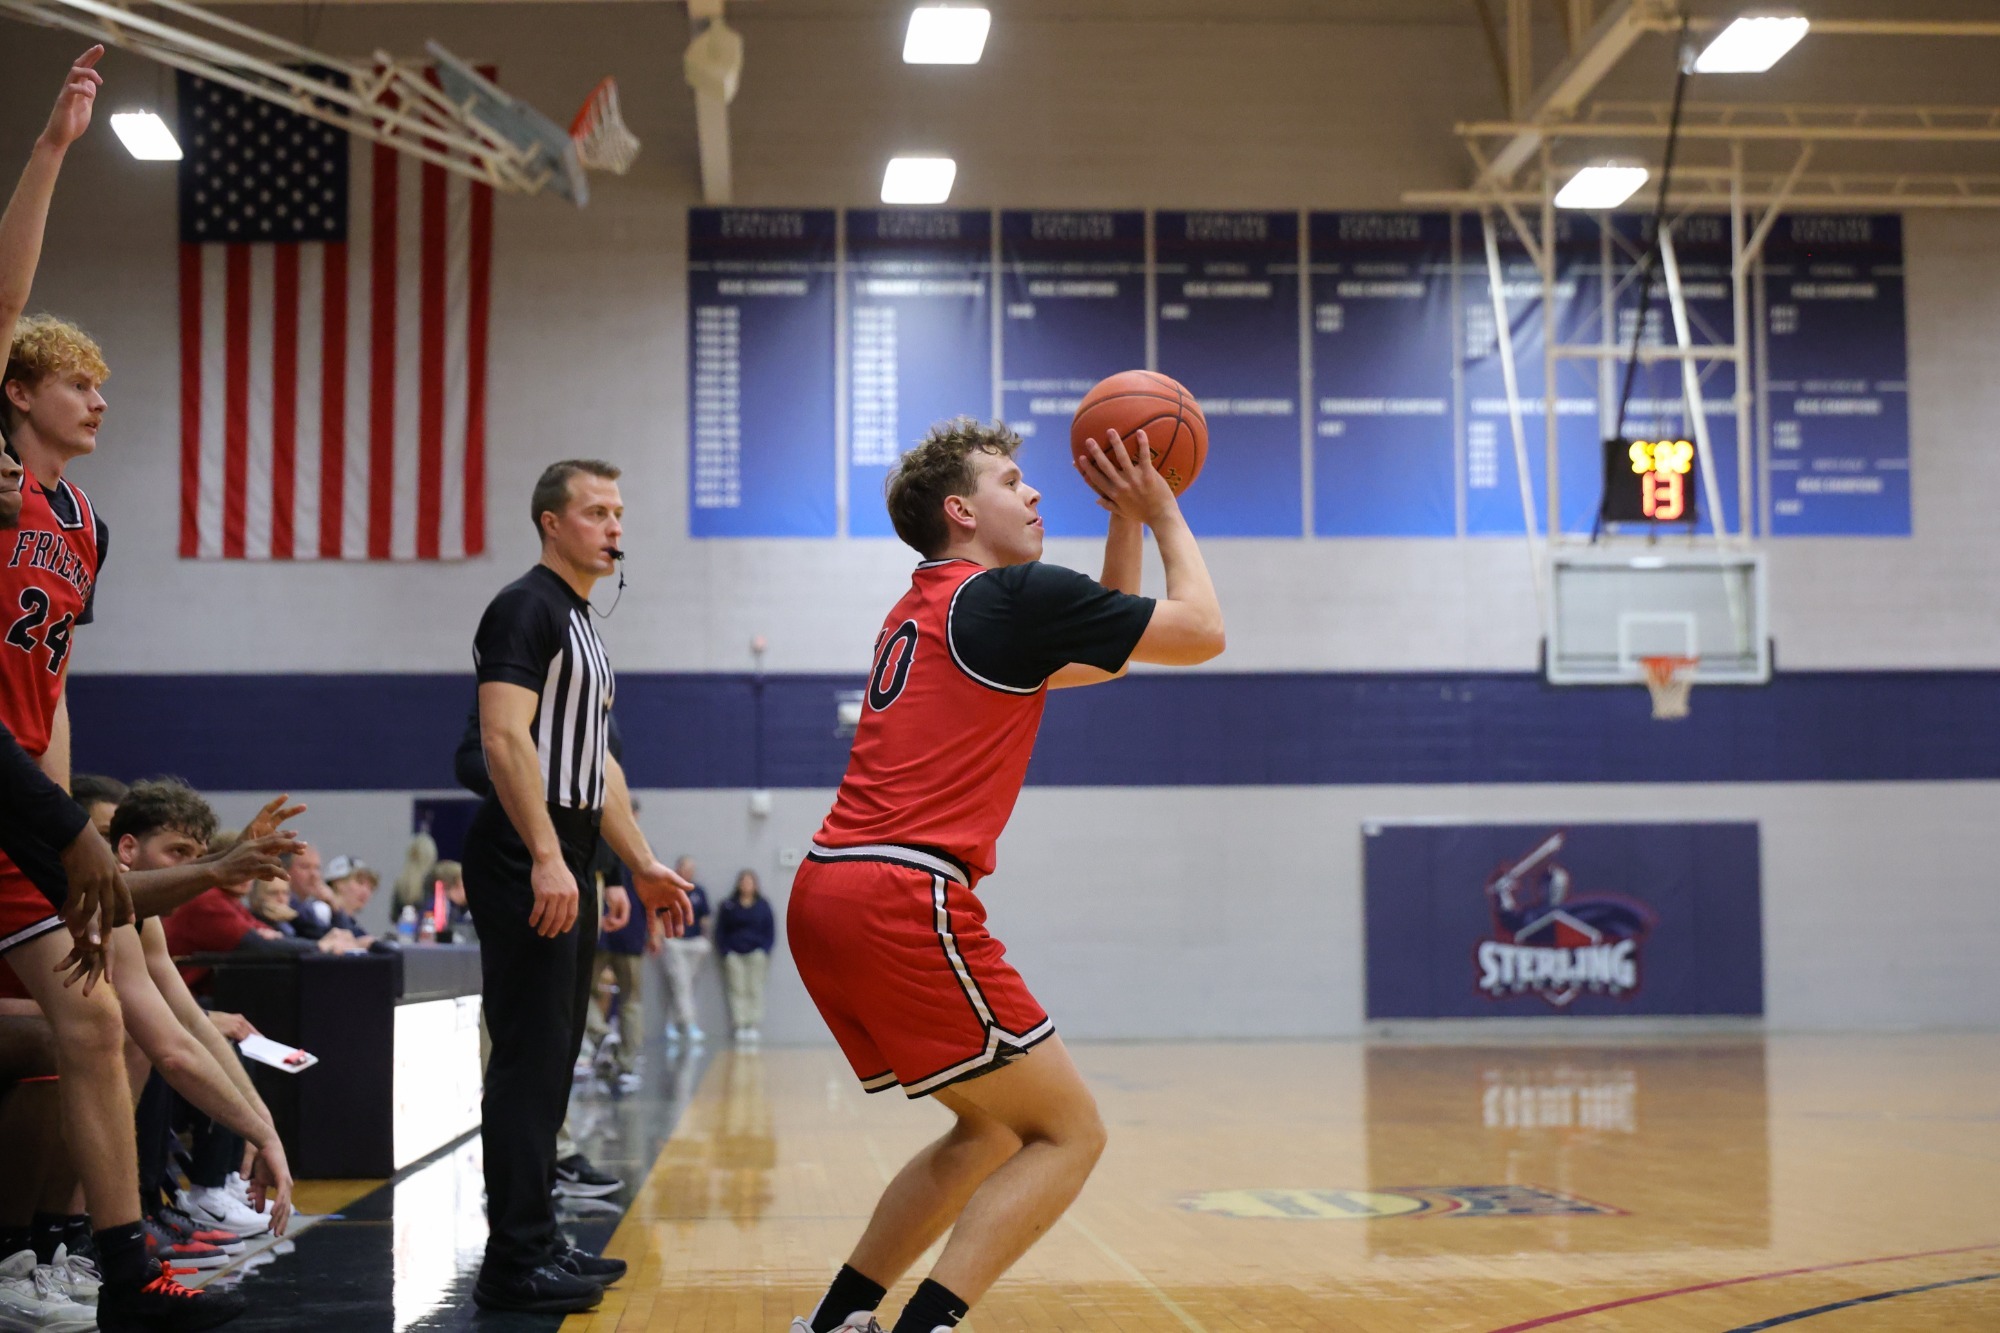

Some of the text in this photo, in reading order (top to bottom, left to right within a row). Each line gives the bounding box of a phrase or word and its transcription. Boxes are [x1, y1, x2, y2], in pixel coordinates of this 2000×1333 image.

[1642, 471, 1684, 520] 13
[4, 586, 75, 676] 24
[1478, 940, 1636, 988] STERLING
